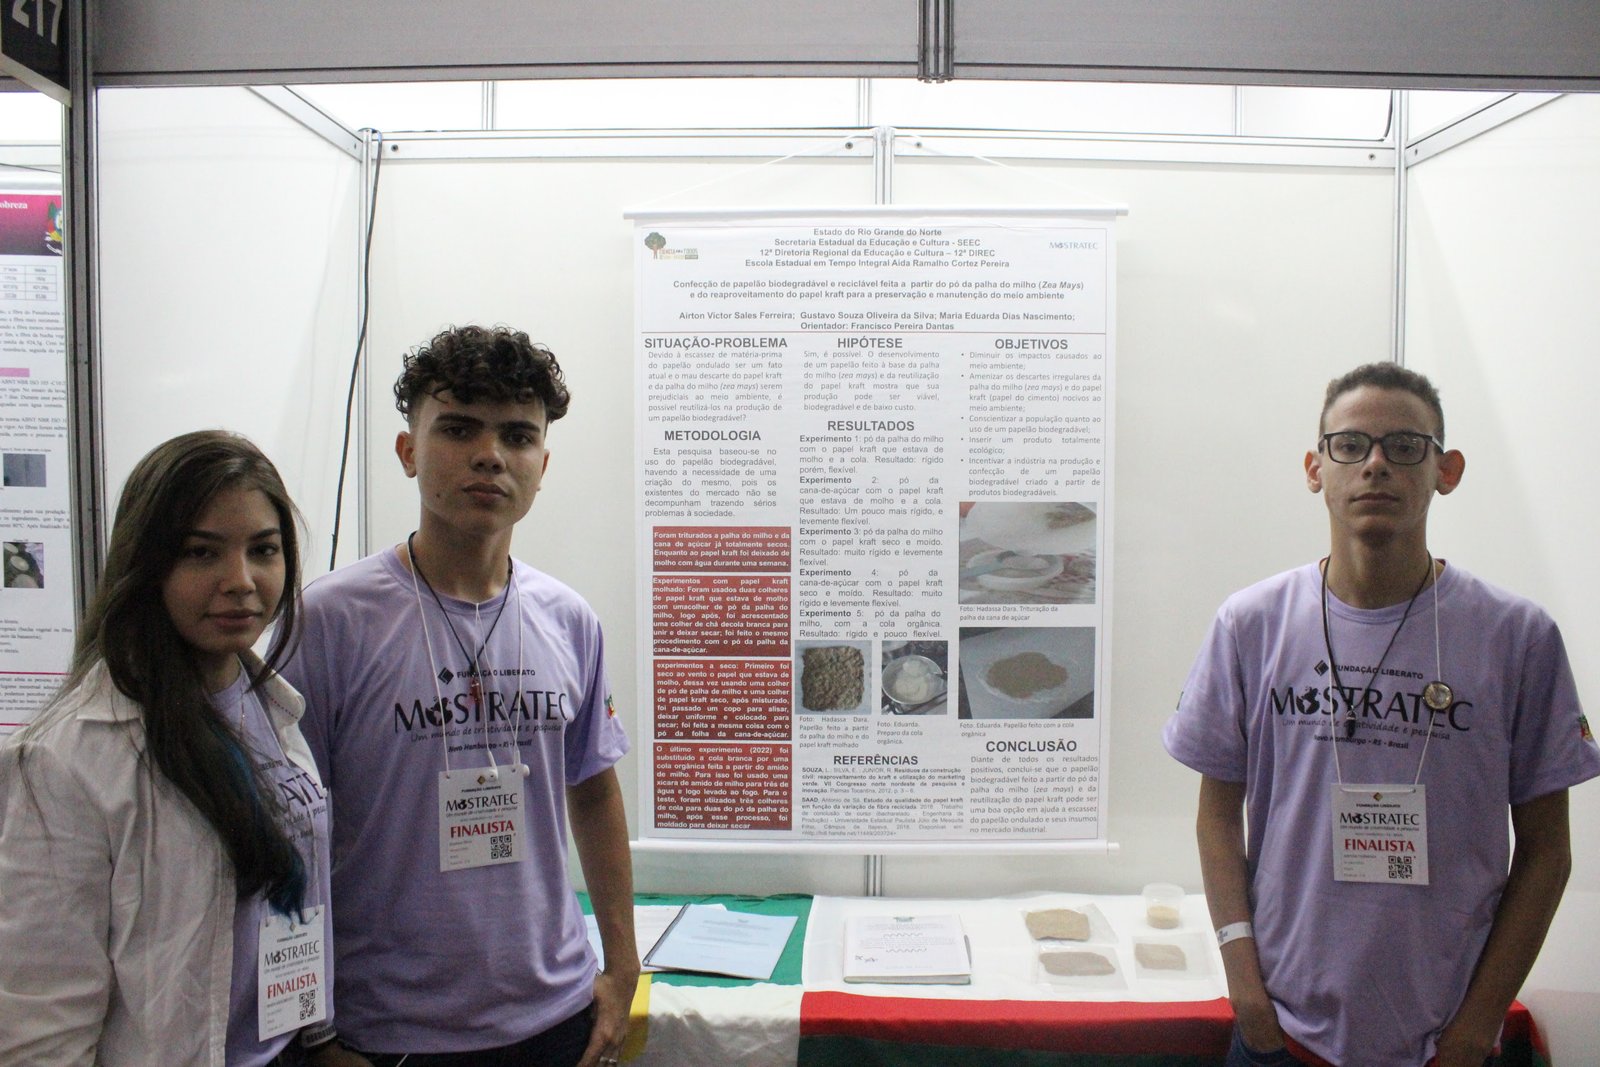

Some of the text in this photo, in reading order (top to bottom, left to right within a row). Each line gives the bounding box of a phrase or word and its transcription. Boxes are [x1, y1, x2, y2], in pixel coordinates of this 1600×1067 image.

[813, 228, 942, 236] Estado do Rio Grande do Norte
[774, 238, 817, 246] Secretaria
[818, 238, 855, 246] Estadual
[857, 238, 867, 246] da
[869, 238, 911, 248] Educação
[919, 238, 950, 247] Cultura
[957, 239, 981, 247] SEEC
[760, 248, 774, 257] 12ª
[774, 248, 811, 257] Diretoria
[812, 248, 849, 258] Regional
[851, 249, 862, 257] da
[863, 249, 905, 258] Educação
[914, 249, 944, 257] Cultura
[954, 249, 967, 257] 12ª
[968, 249, 995, 257] DIREC
[745, 259, 773, 267] Escola
[775, 259, 812, 267] Estadual
[828, 259, 857, 269] Tempo
[858, 259, 890, 269] Integral
[891, 259, 911, 267] Aida
[912, 259, 950, 267] Ramalho
[951, 259, 978, 268] Cortez
[980, 259, 1010, 268] Pereira
[673, 280, 718, 289] Confecção
[720, 280, 731, 288] de
[733, 280, 767, 290] papelão
[768, 280, 829, 290] biodegradável
[838, 280, 878, 288] reciclável
[880, 280, 899, 288] feita
[911, 280, 934, 290] partir
[935, 280, 947, 288] do
[948, 280, 960, 290] pó
[961, 280, 973, 289] da
[974, 280, 998, 290] palha
[999, 280, 1011, 289] do
[1012, 280, 1037, 289] milho
[1038, 281, 1057, 290] (Zea
[1059, 281, 1084, 291] Mays)
[697, 290, 708, 299] do
[710, 290, 785, 300] reaproveitamento
[786, 291, 798, 299] do
[799, 291, 823, 300] papel
[825, 291, 844, 299] kraft
[846, 292, 865, 301] para
[874, 291, 927, 301] preservação
[936, 291, 988, 301] manutenção
[990, 291, 1002, 299] do
[1003, 291, 1024, 299] meio
[1026, 291, 1065, 300] ambiente
[679, 311, 1075, 322] Airton Victor Sales Ferreira; Gustavo Souza Oliveira da Silva; Maria Eduarda Dias Nascimento;
[800, 322, 954, 330] Orientador: Francisco Pereira Dantas
[644, 336, 788, 350] SITUAÇÃO-PROBLEMA
[838, 336, 903, 348] HIPÓTESE
[995, 339, 1068, 350] OBJETIVOS
[1018, 352, 1051, 360] impactos
[828, 421, 915, 431] RESULTADOS
[664, 430, 761, 441] METODOLOGIA
[678, 448, 712, 456] pesquisa
[800, 569, 852, 577] Experimento
[899, 569, 909, 577] pó
[1381, 668, 1424, 679] LIBERATO
[986, 739, 1077, 752] CONCLUSÃO
[834, 754, 918, 765] REFERÊNCIAS
[451, 820, 515, 838] FINALISTA
[1345, 839, 1415, 852] FINALISTA
[267, 972, 317, 999] FINALISTA
